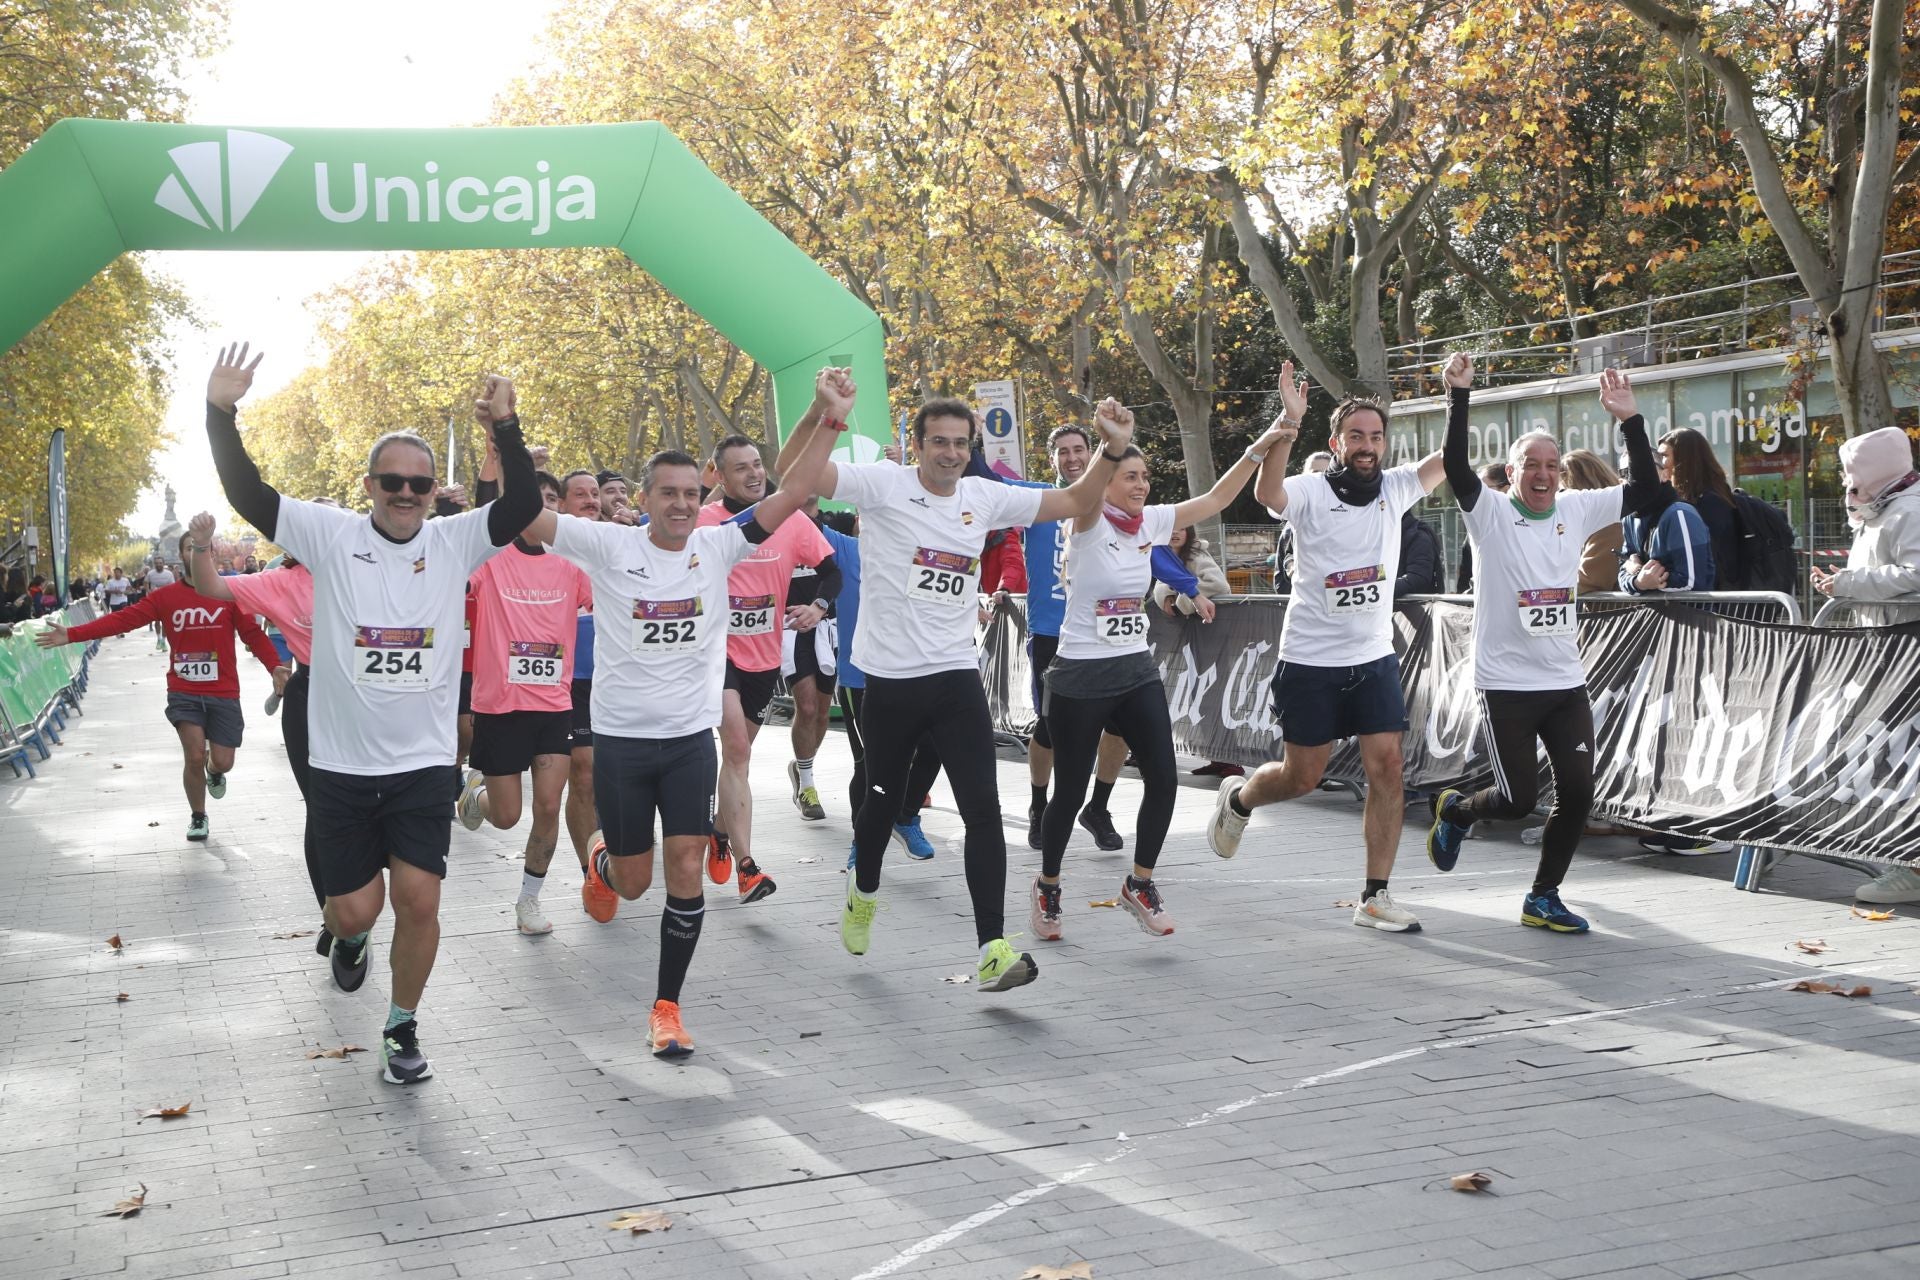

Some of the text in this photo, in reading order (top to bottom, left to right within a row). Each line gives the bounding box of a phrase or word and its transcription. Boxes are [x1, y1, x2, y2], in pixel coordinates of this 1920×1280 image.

[314, 160, 596, 236] Unicaja
[1688, 392, 1807, 453] amiga
[917, 569, 965, 596] 250
[1336, 585, 1380, 607] 253
[172, 606, 224, 632] gmv
[730, 610, 767, 628] 364
[1106, 616, 1145, 637] 255
[1529, 606, 1567, 627] 251
[642, 620, 696, 644] 252
[180, 663, 211, 676] 410
[365, 650, 422, 674] 254
[517, 659, 555, 677] 365
